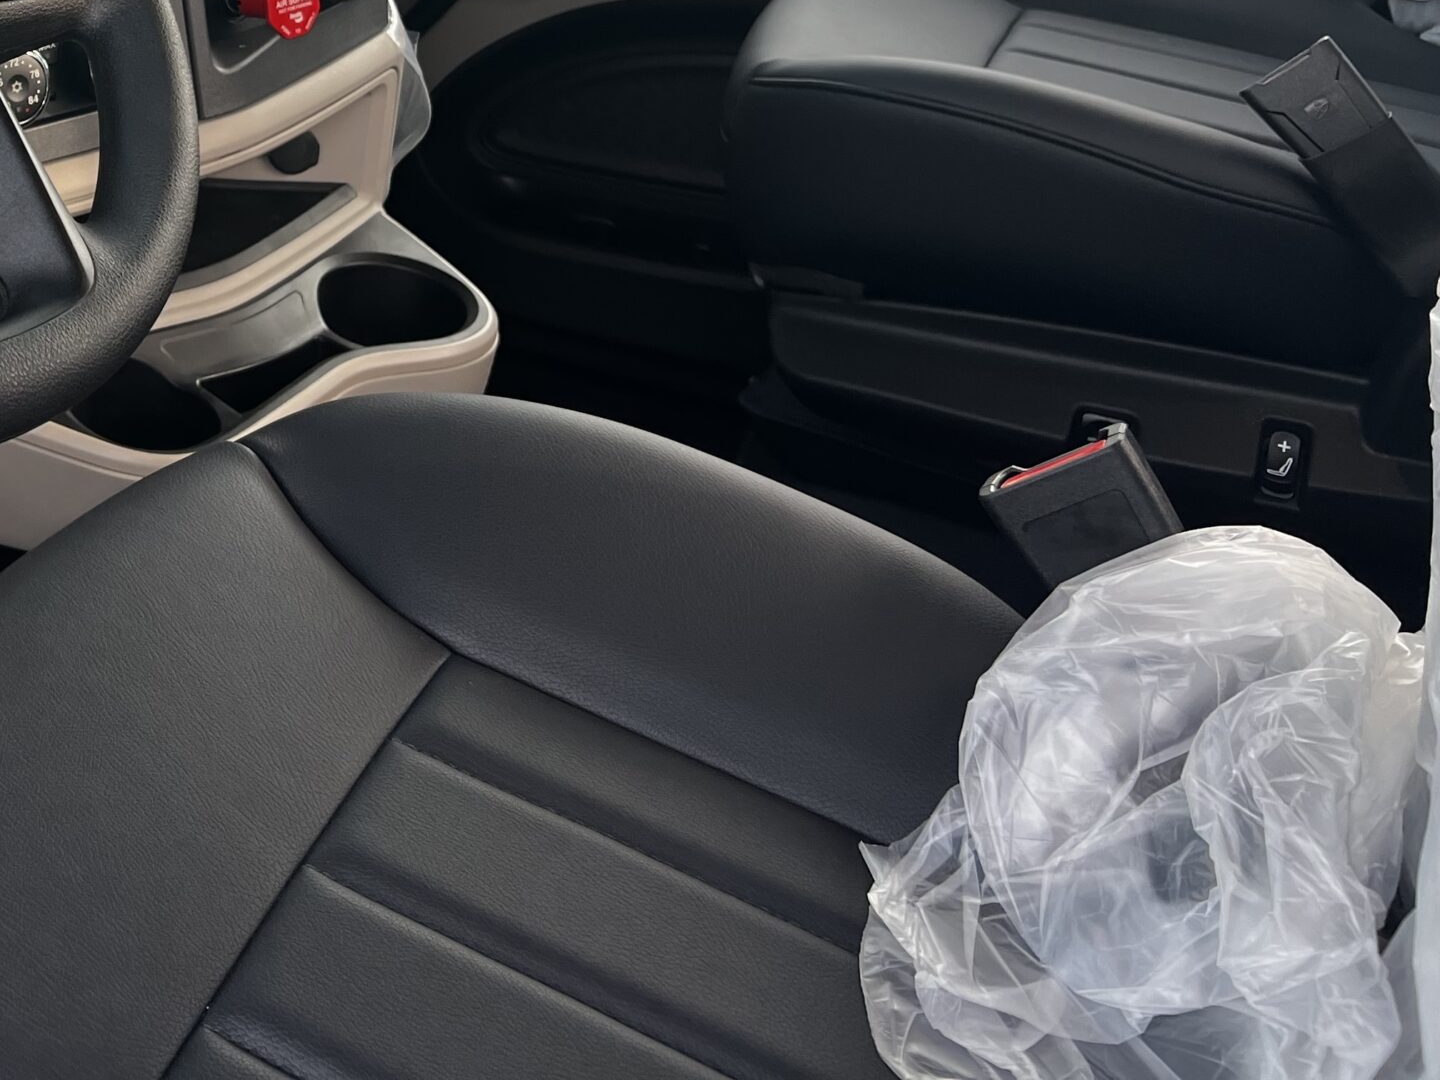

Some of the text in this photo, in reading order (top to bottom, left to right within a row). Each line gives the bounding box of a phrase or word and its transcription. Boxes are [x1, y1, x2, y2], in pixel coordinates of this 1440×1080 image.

[275, 0, 288, 9] AIR
[9, 58, 20, 68] 72
[27, 94, 39, 105] 84
